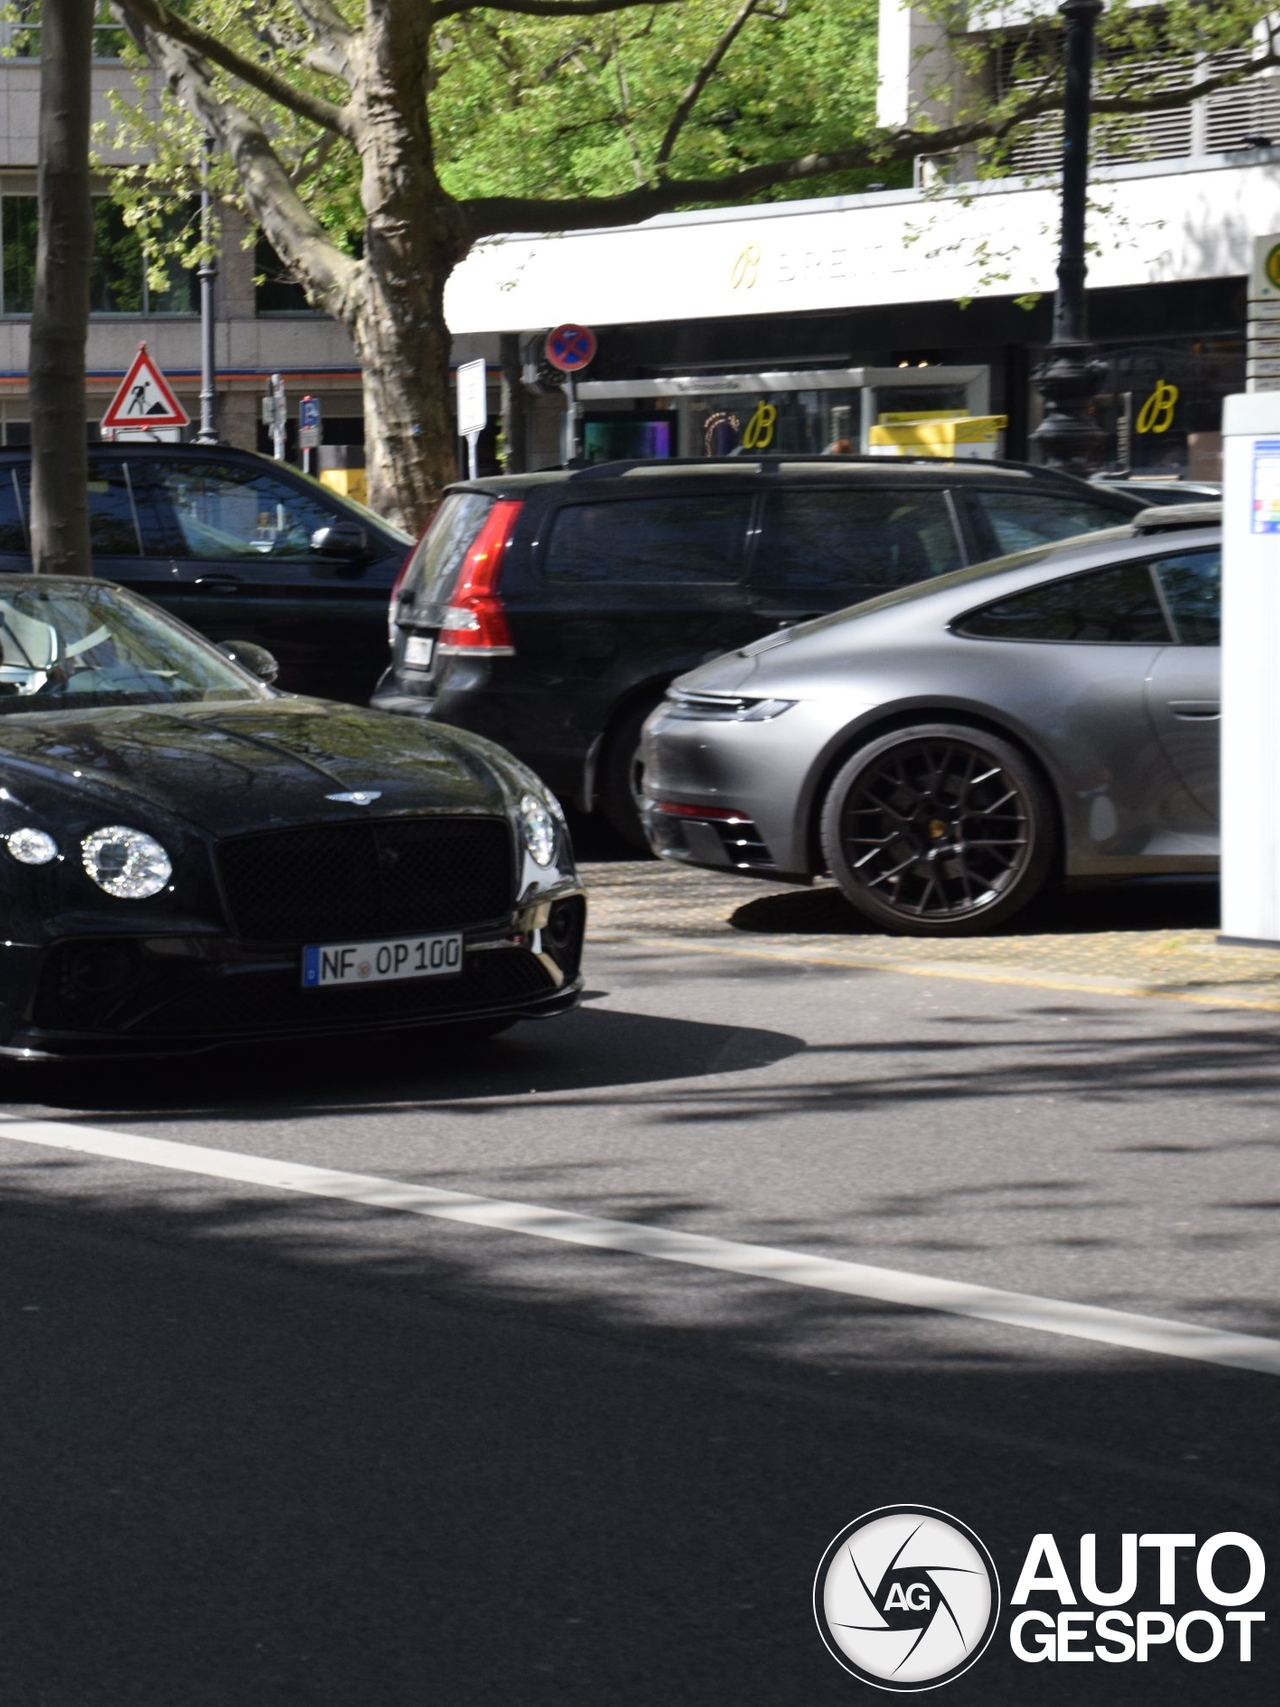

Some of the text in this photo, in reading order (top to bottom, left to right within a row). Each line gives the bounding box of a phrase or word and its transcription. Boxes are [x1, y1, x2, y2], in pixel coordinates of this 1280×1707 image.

[322, 948, 357, 980] NF
[376, 943, 409, 974] OP
[414, 938, 460, 971] 100
